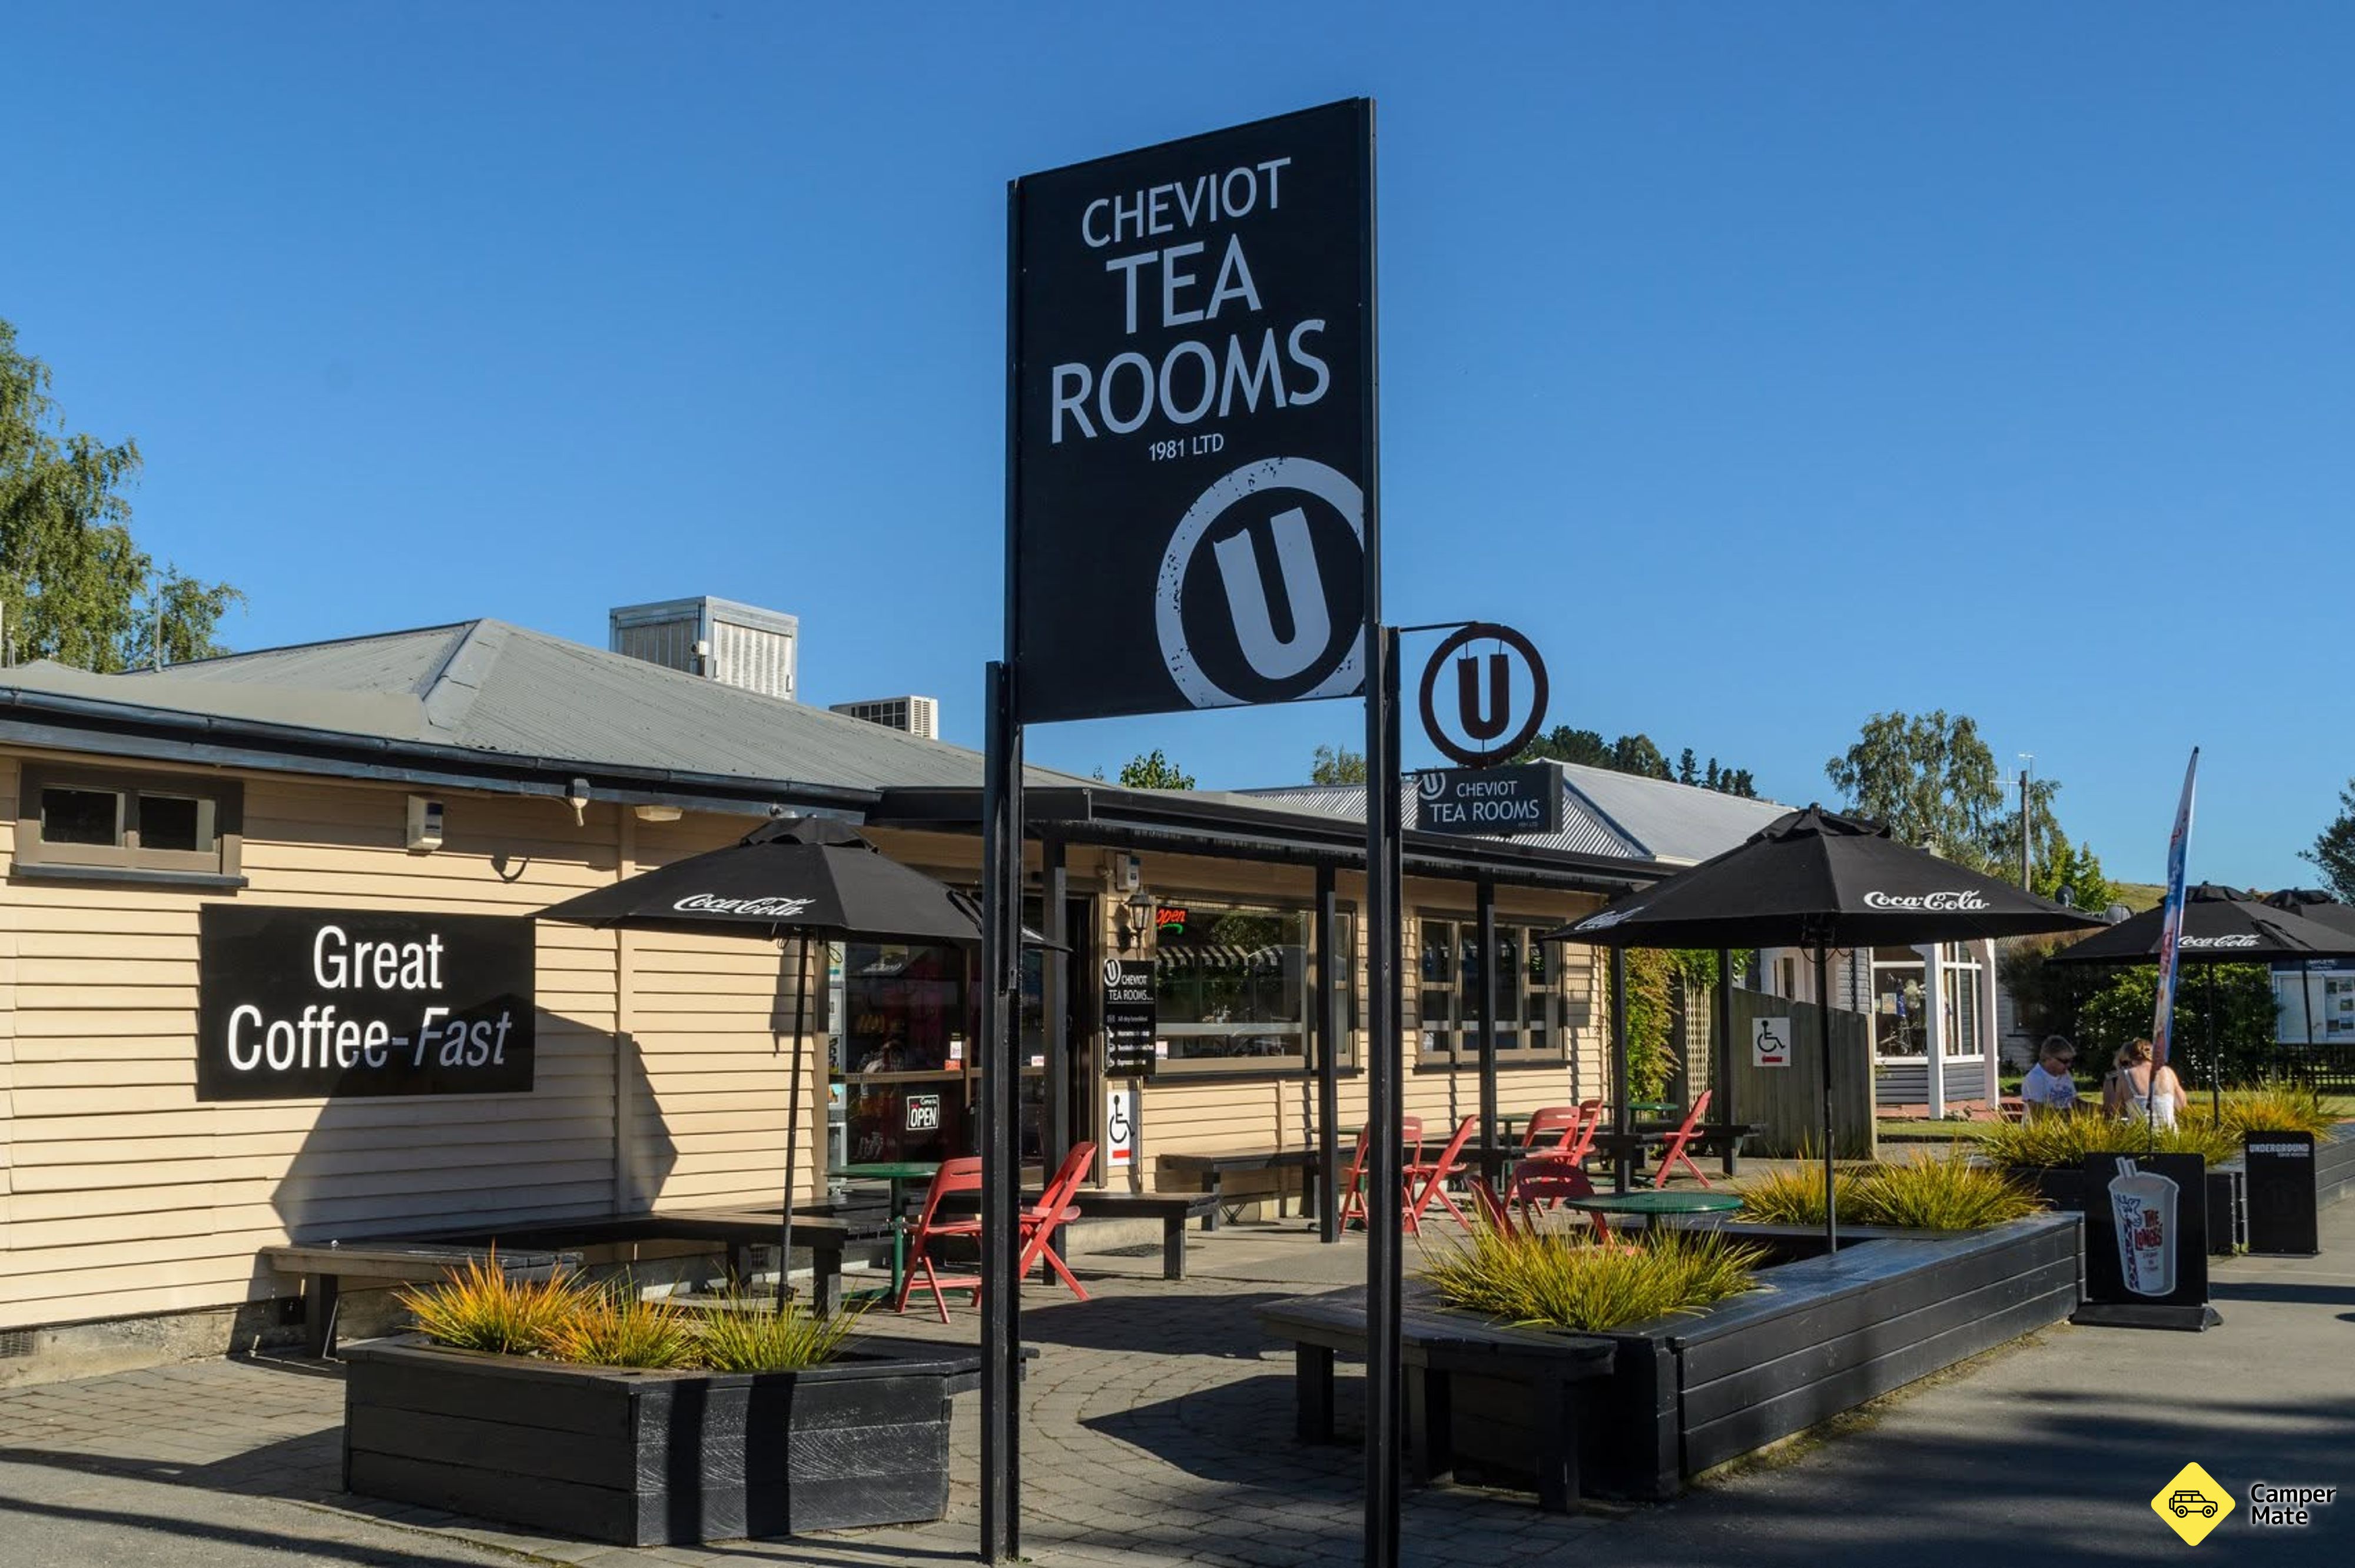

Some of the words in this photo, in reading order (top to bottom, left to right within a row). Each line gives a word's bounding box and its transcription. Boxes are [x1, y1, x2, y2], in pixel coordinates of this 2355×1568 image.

[1082, 157, 1291, 248] CHEVIOT
[1106, 234, 1262, 334] TEA
[1052, 319, 1330, 443] ROOMS
[1149, 438, 1185, 461] 1981
[1193, 433, 1224, 454] LTD
[1457, 781, 1518, 798] CHEVIOT
[1429, 802, 1466, 823] TEA
[1472, 799, 1540, 820] ROOMS
[1863, 890, 1991, 911] Coca-Cola
[313, 925, 444, 990] Great
[1121, 975, 1147, 985] CHEVIOT
[1108, 989, 1122, 1001] TEA
[414, 1007, 512, 1067] Fast
[910, 1107, 937, 1127] OPEN
[2249, 1144, 2310, 1152] UNDERGROUND
